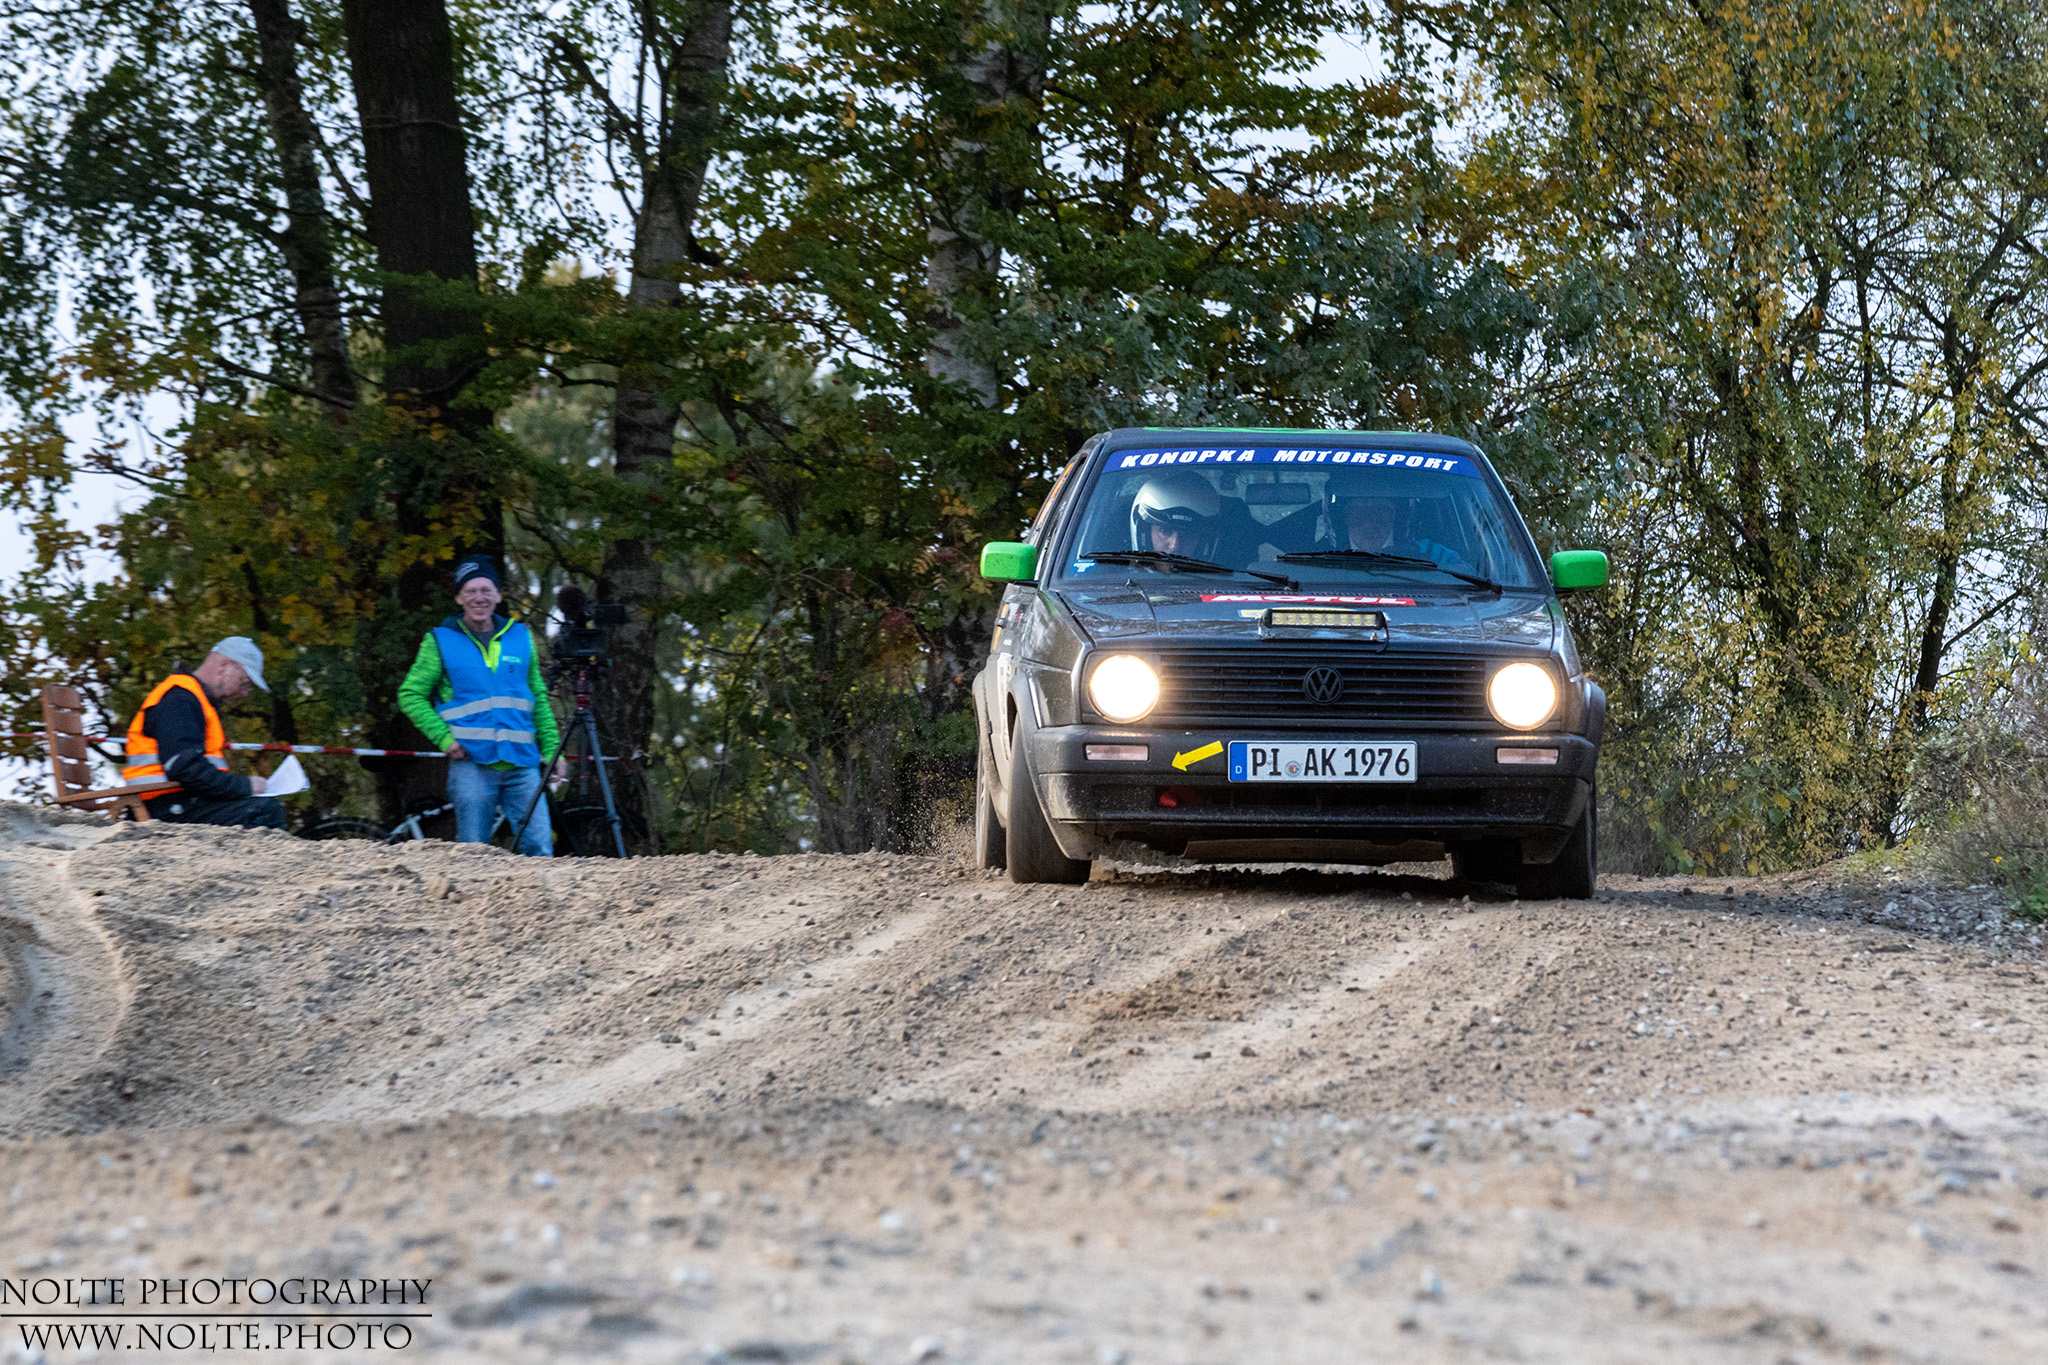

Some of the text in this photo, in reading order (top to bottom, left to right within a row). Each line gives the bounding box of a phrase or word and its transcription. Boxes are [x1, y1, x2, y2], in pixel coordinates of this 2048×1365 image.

[1120, 450, 1458, 471] KONOPKA MOTORSPORT
[1211, 594, 1407, 605] MOTUL
[1235, 765, 1243, 774] D
[1251, 748, 1410, 776] PI AK 1976
